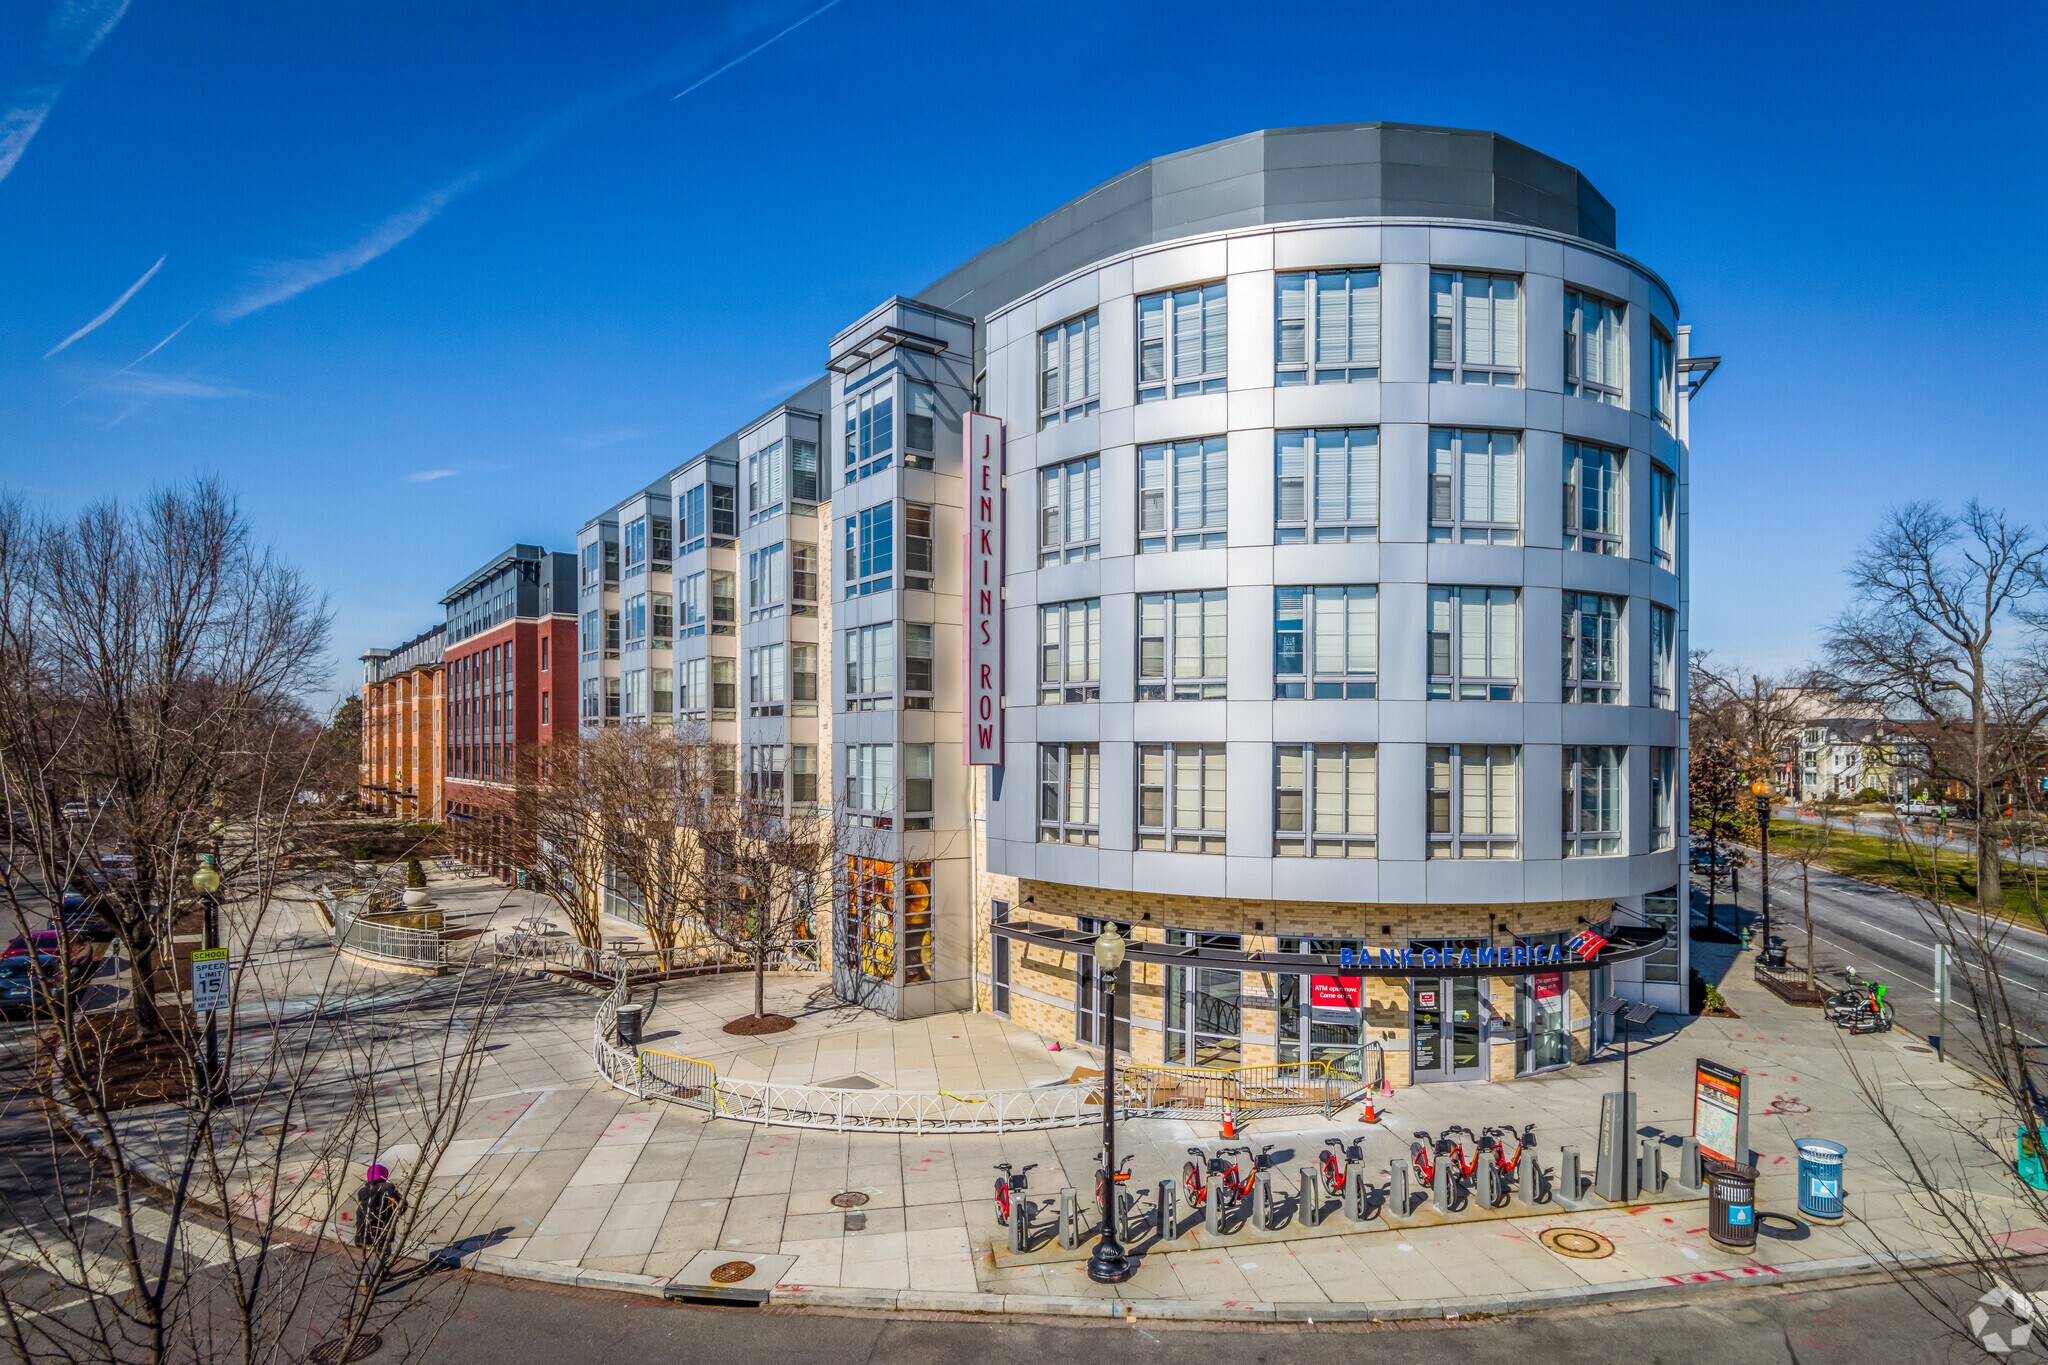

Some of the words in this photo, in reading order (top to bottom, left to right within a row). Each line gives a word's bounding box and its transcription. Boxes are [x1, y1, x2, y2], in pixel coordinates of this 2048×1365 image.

[980, 433, 993, 647] JENKINS
[977, 662, 994, 751] ROW
[194, 951, 226, 959] SCHOOL
[1340, 947, 1415, 966] BANK
[1422, 947, 1455, 966] OF
[1459, 944, 1563, 965] AMERICA
[196, 963, 226, 971] SPEED
[200, 979, 222, 994] 15
